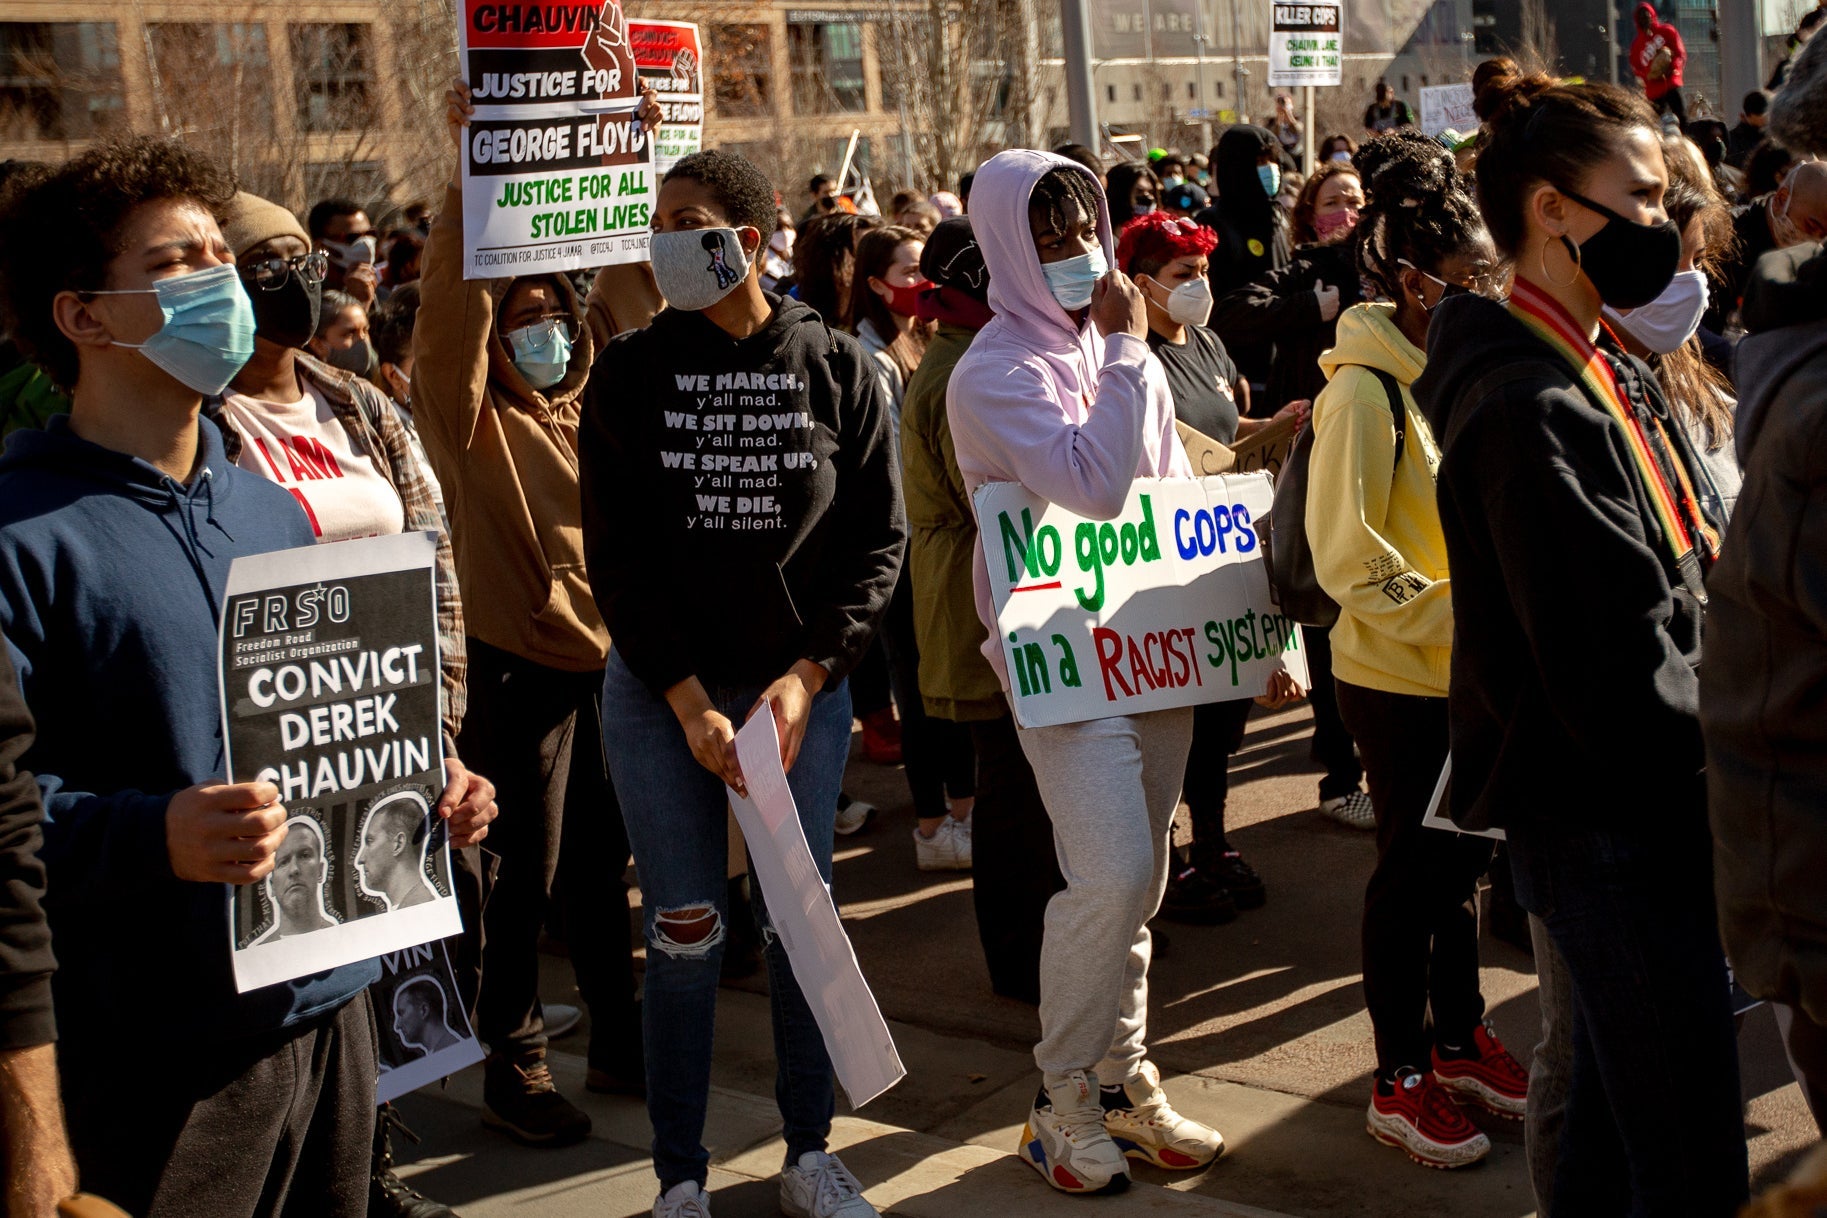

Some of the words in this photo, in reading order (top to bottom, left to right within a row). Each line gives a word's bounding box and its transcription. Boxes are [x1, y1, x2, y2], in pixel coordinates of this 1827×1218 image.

[473, 4, 601, 34] CHAUVIN
[1113, 13, 1144, 33] WE
[1154, 13, 1192, 32] ARE
[1275, 6, 1311, 25] KILLER
[1312, 6, 1336, 25] COPS
[472, 70, 577, 98] JUSTICE
[581, 68, 622, 94] FOR
[472, 125, 571, 165] GEORGE
[577, 120, 646, 158] FLOYD
[497, 177, 573, 208] JUSTICE
[579, 174, 611, 201] FOR
[618, 170, 649, 197] ALL
[530, 208, 597, 239] STOLEN
[603, 202, 649, 231] LIVES
[474, 254, 484, 267] TC
[484, 252, 518, 266] COALITION
[518, 250, 532, 263] FOR
[533, 248, 557, 262] JUSTICE
[675, 374, 710, 392] WE
[715, 372, 805, 392] MARCH,
[696, 393, 733, 410] y'all
[740, 393, 782, 407] mad.
[664, 410, 698, 430] WE
[702, 414, 736, 431] SIT
[742, 412, 815, 431] DOWN,
[696, 434, 732, 449] y'all
[740, 433, 783, 447] mad.
[254, 438, 287, 483] I
[277, 435, 345, 482] AM
[660, 451, 696, 470] WE
[701, 454, 778, 472] SPEAK
[783, 452, 818, 471] UP,
[694, 474, 732, 488] y'all
[739, 474, 783, 488] mad.
[696, 494, 731, 513] WE
[736, 496, 782, 515] DIE,
[687, 514, 724, 529] y'all
[731, 516, 788, 530] silent.
[998, 507, 1062, 584] No
[1074, 493, 1162, 613] good
[1174, 503, 1256, 561] COPS
[233, 583, 350, 638] FRSO
[236, 637, 281, 653] Freedom
[285, 631, 312, 646] Road
[236, 647, 286, 667] Socialist
[289, 639, 359, 659] Organization
[1008, 631, 1052, 698] in
[1051, 633, 1083, 688] a
[1092, 627, 1203, 702] RACIST
[1203, 608, 1299, 687] system
[248, 644, 423, 708] CONVICT
[279, 692, 400, 752] DEREK
[255, 736, 430, 803] CHAUVIN
